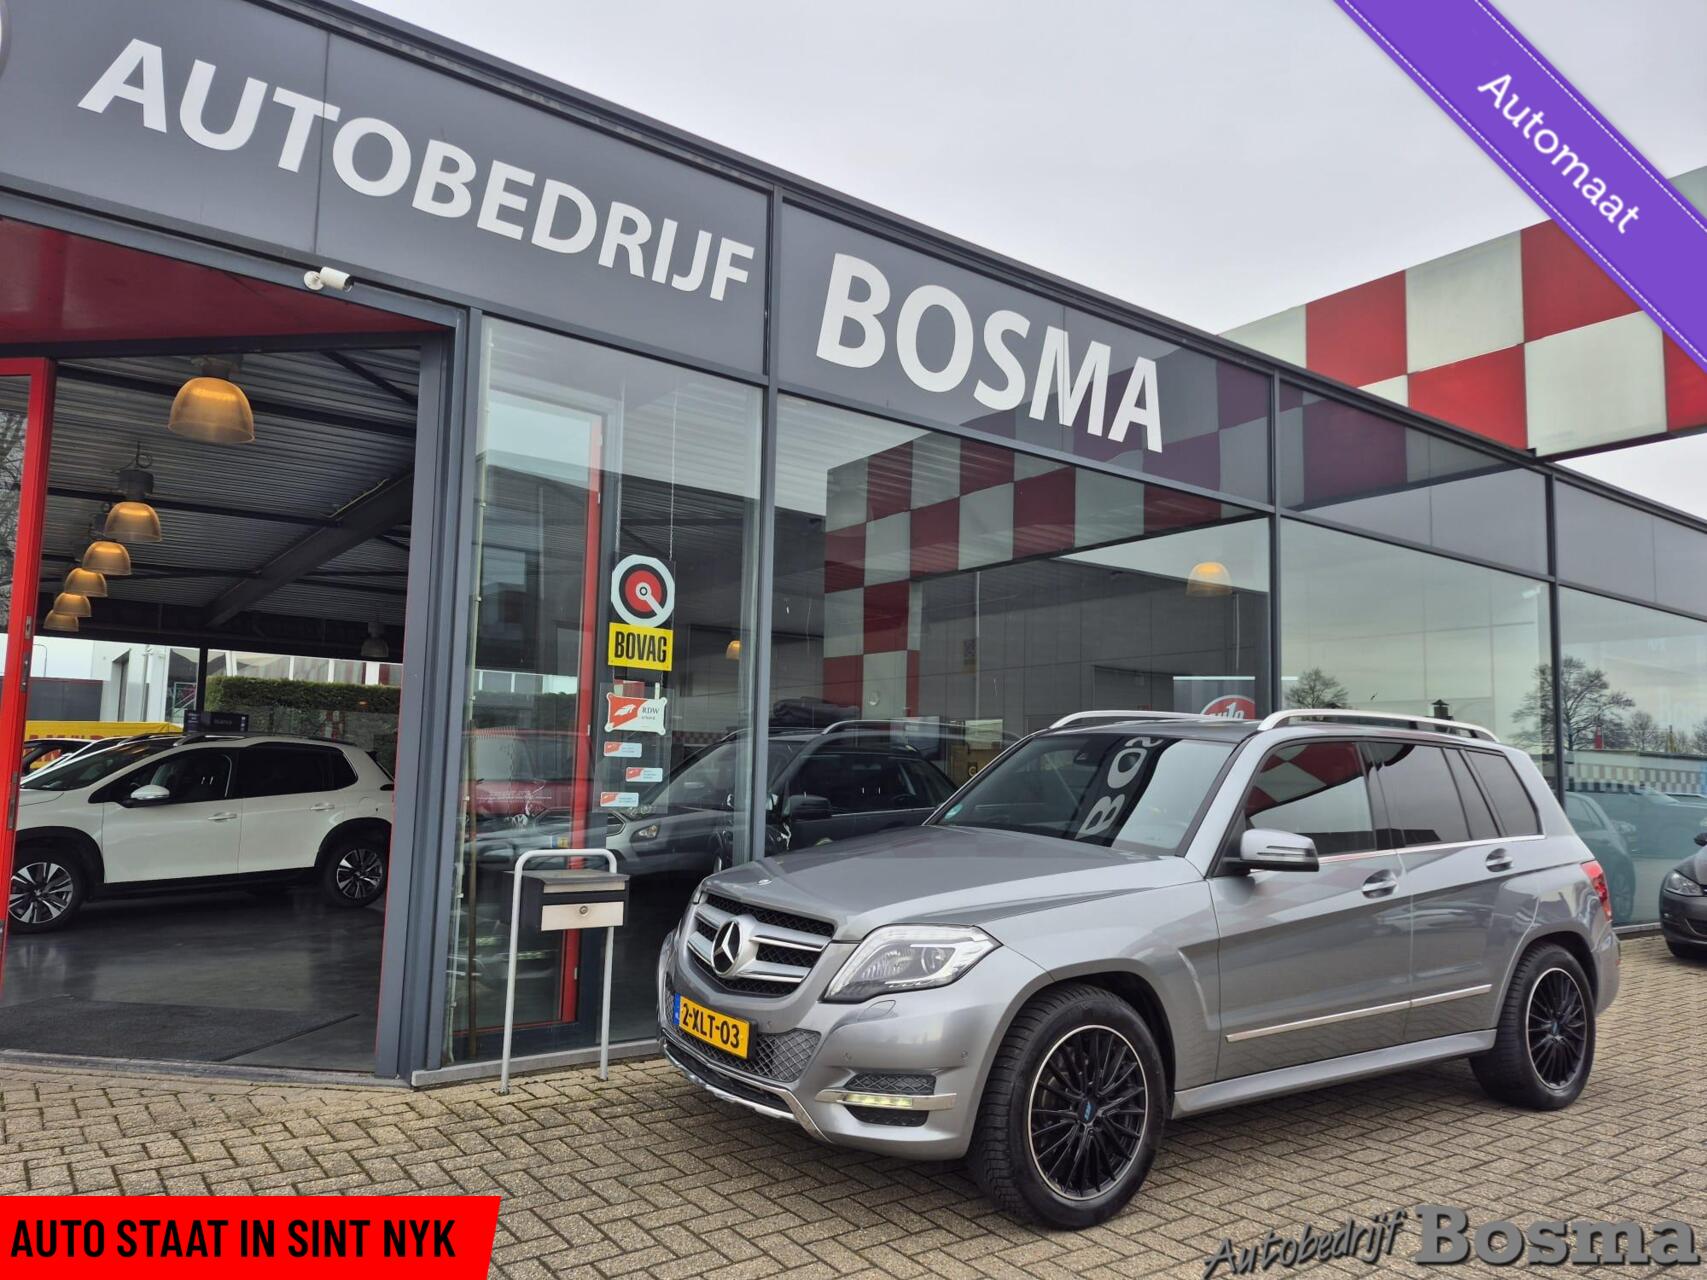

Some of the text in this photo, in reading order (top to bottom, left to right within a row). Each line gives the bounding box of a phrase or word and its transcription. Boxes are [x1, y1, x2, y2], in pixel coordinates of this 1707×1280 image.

[77, 38, 1163, 453] AUTOBEDRIJF BOSMA
[613, 631, 667, 663] BOVAG
[682, 1002, 740, 1049] 2-XLT-03
